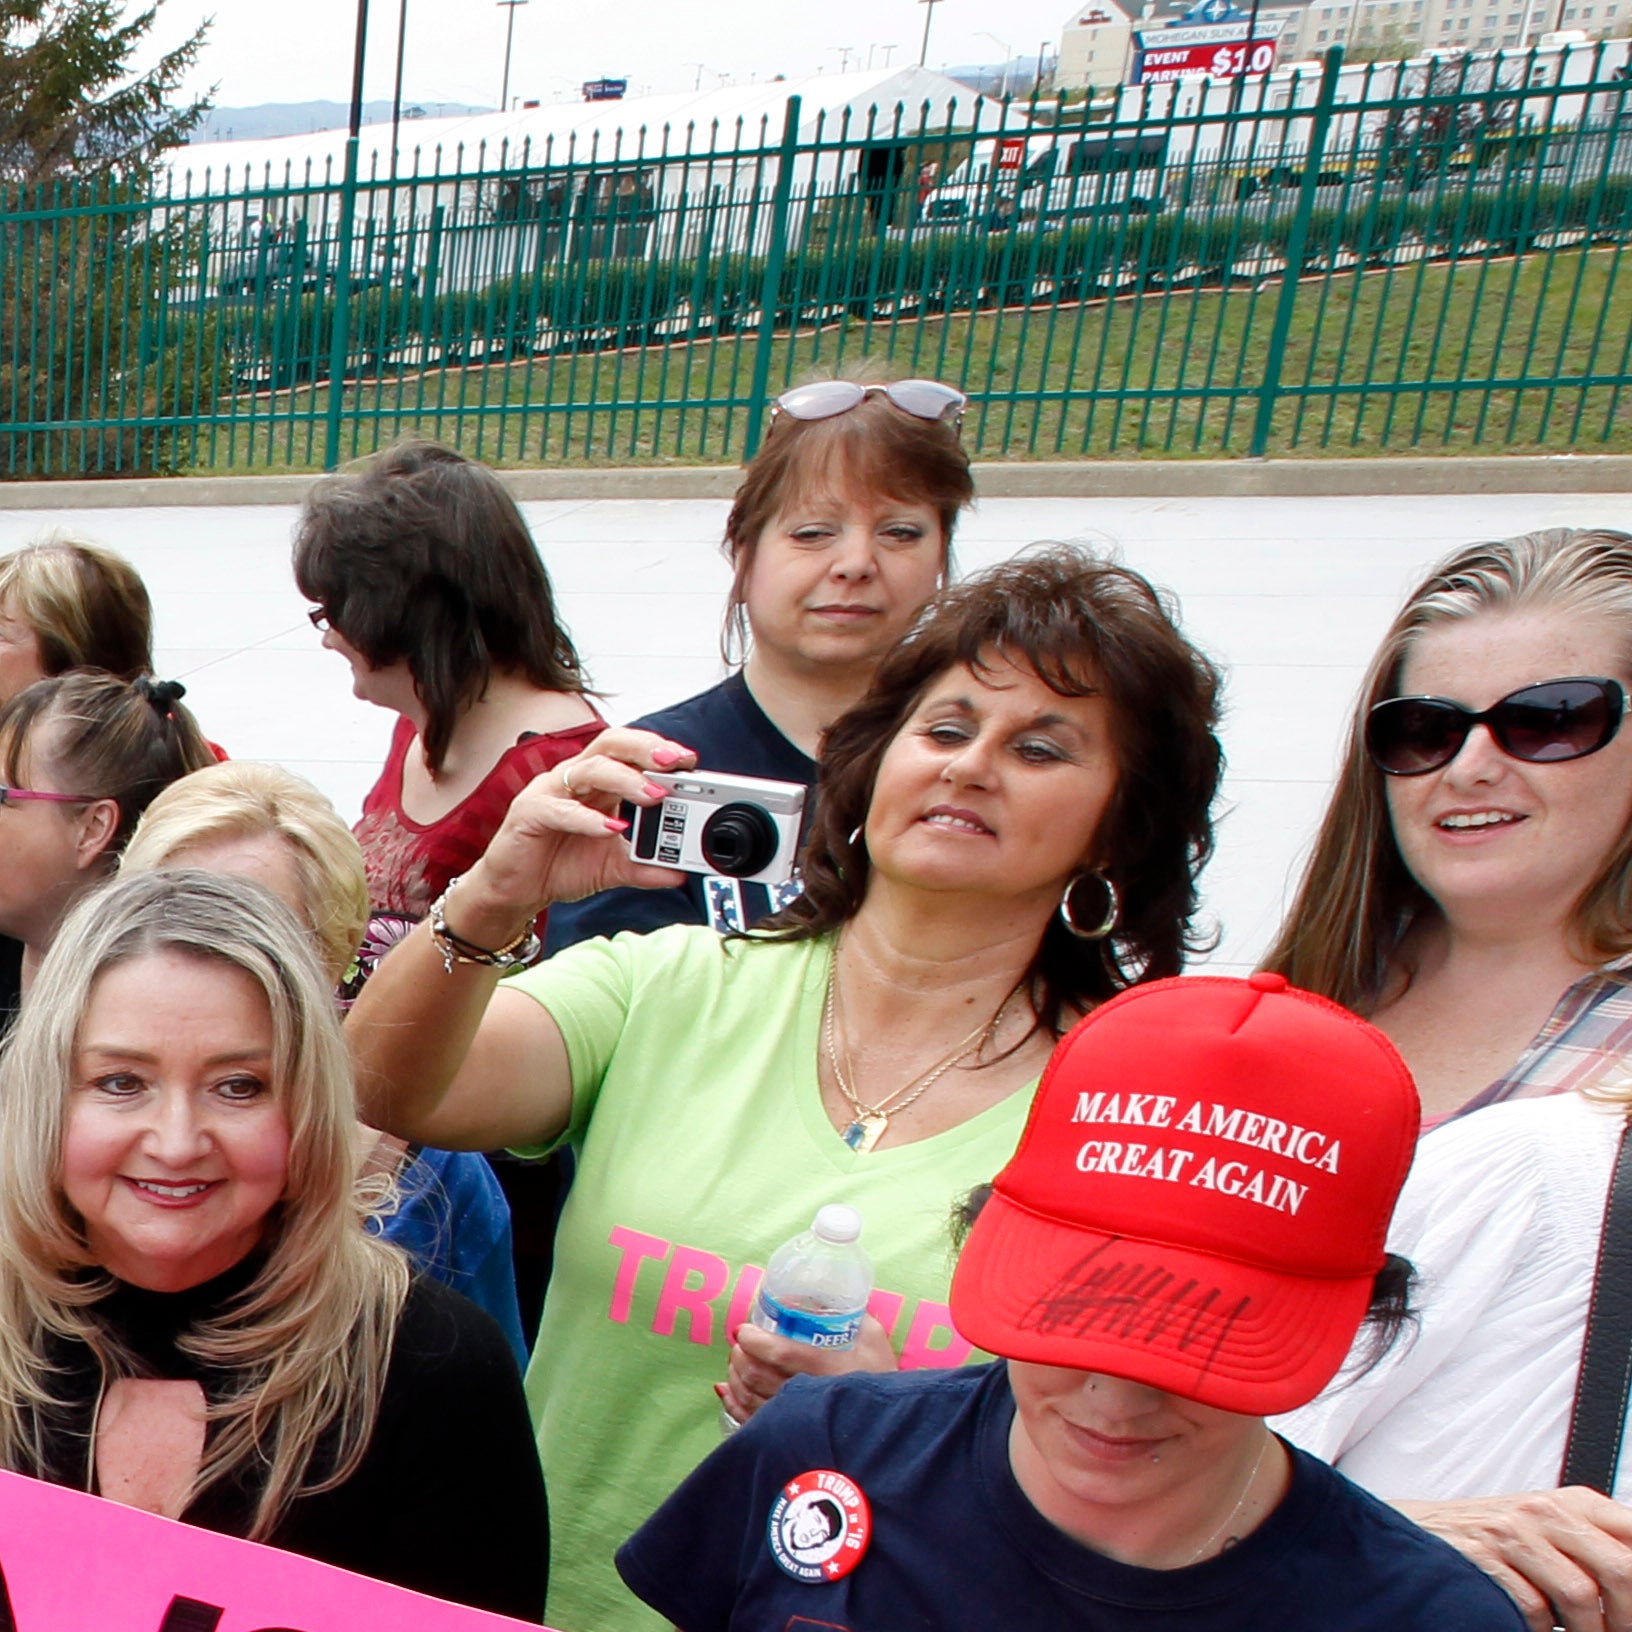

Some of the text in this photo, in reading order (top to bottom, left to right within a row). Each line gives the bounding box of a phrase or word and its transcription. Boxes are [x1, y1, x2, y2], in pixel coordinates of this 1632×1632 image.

[1145, 24, 1279, 44] MOHEGAN SUN AENA
[1143, 51, 1191, 66] EVENT
[999, 146, 1020, 163] XIT
[668, 803, 684, 812] 12.1
[1071, 1092, 1341, 1175] MAKE AMERICA
[1075, 1141, 1309, 1216] GREAT AGAIN
[811, 1331, 849, 1348] DEER
[817, 1473, 860, 1508] TRUMP
[770, 1497, 822, 1578] MAKE AMERICA GREAT AGAIN
